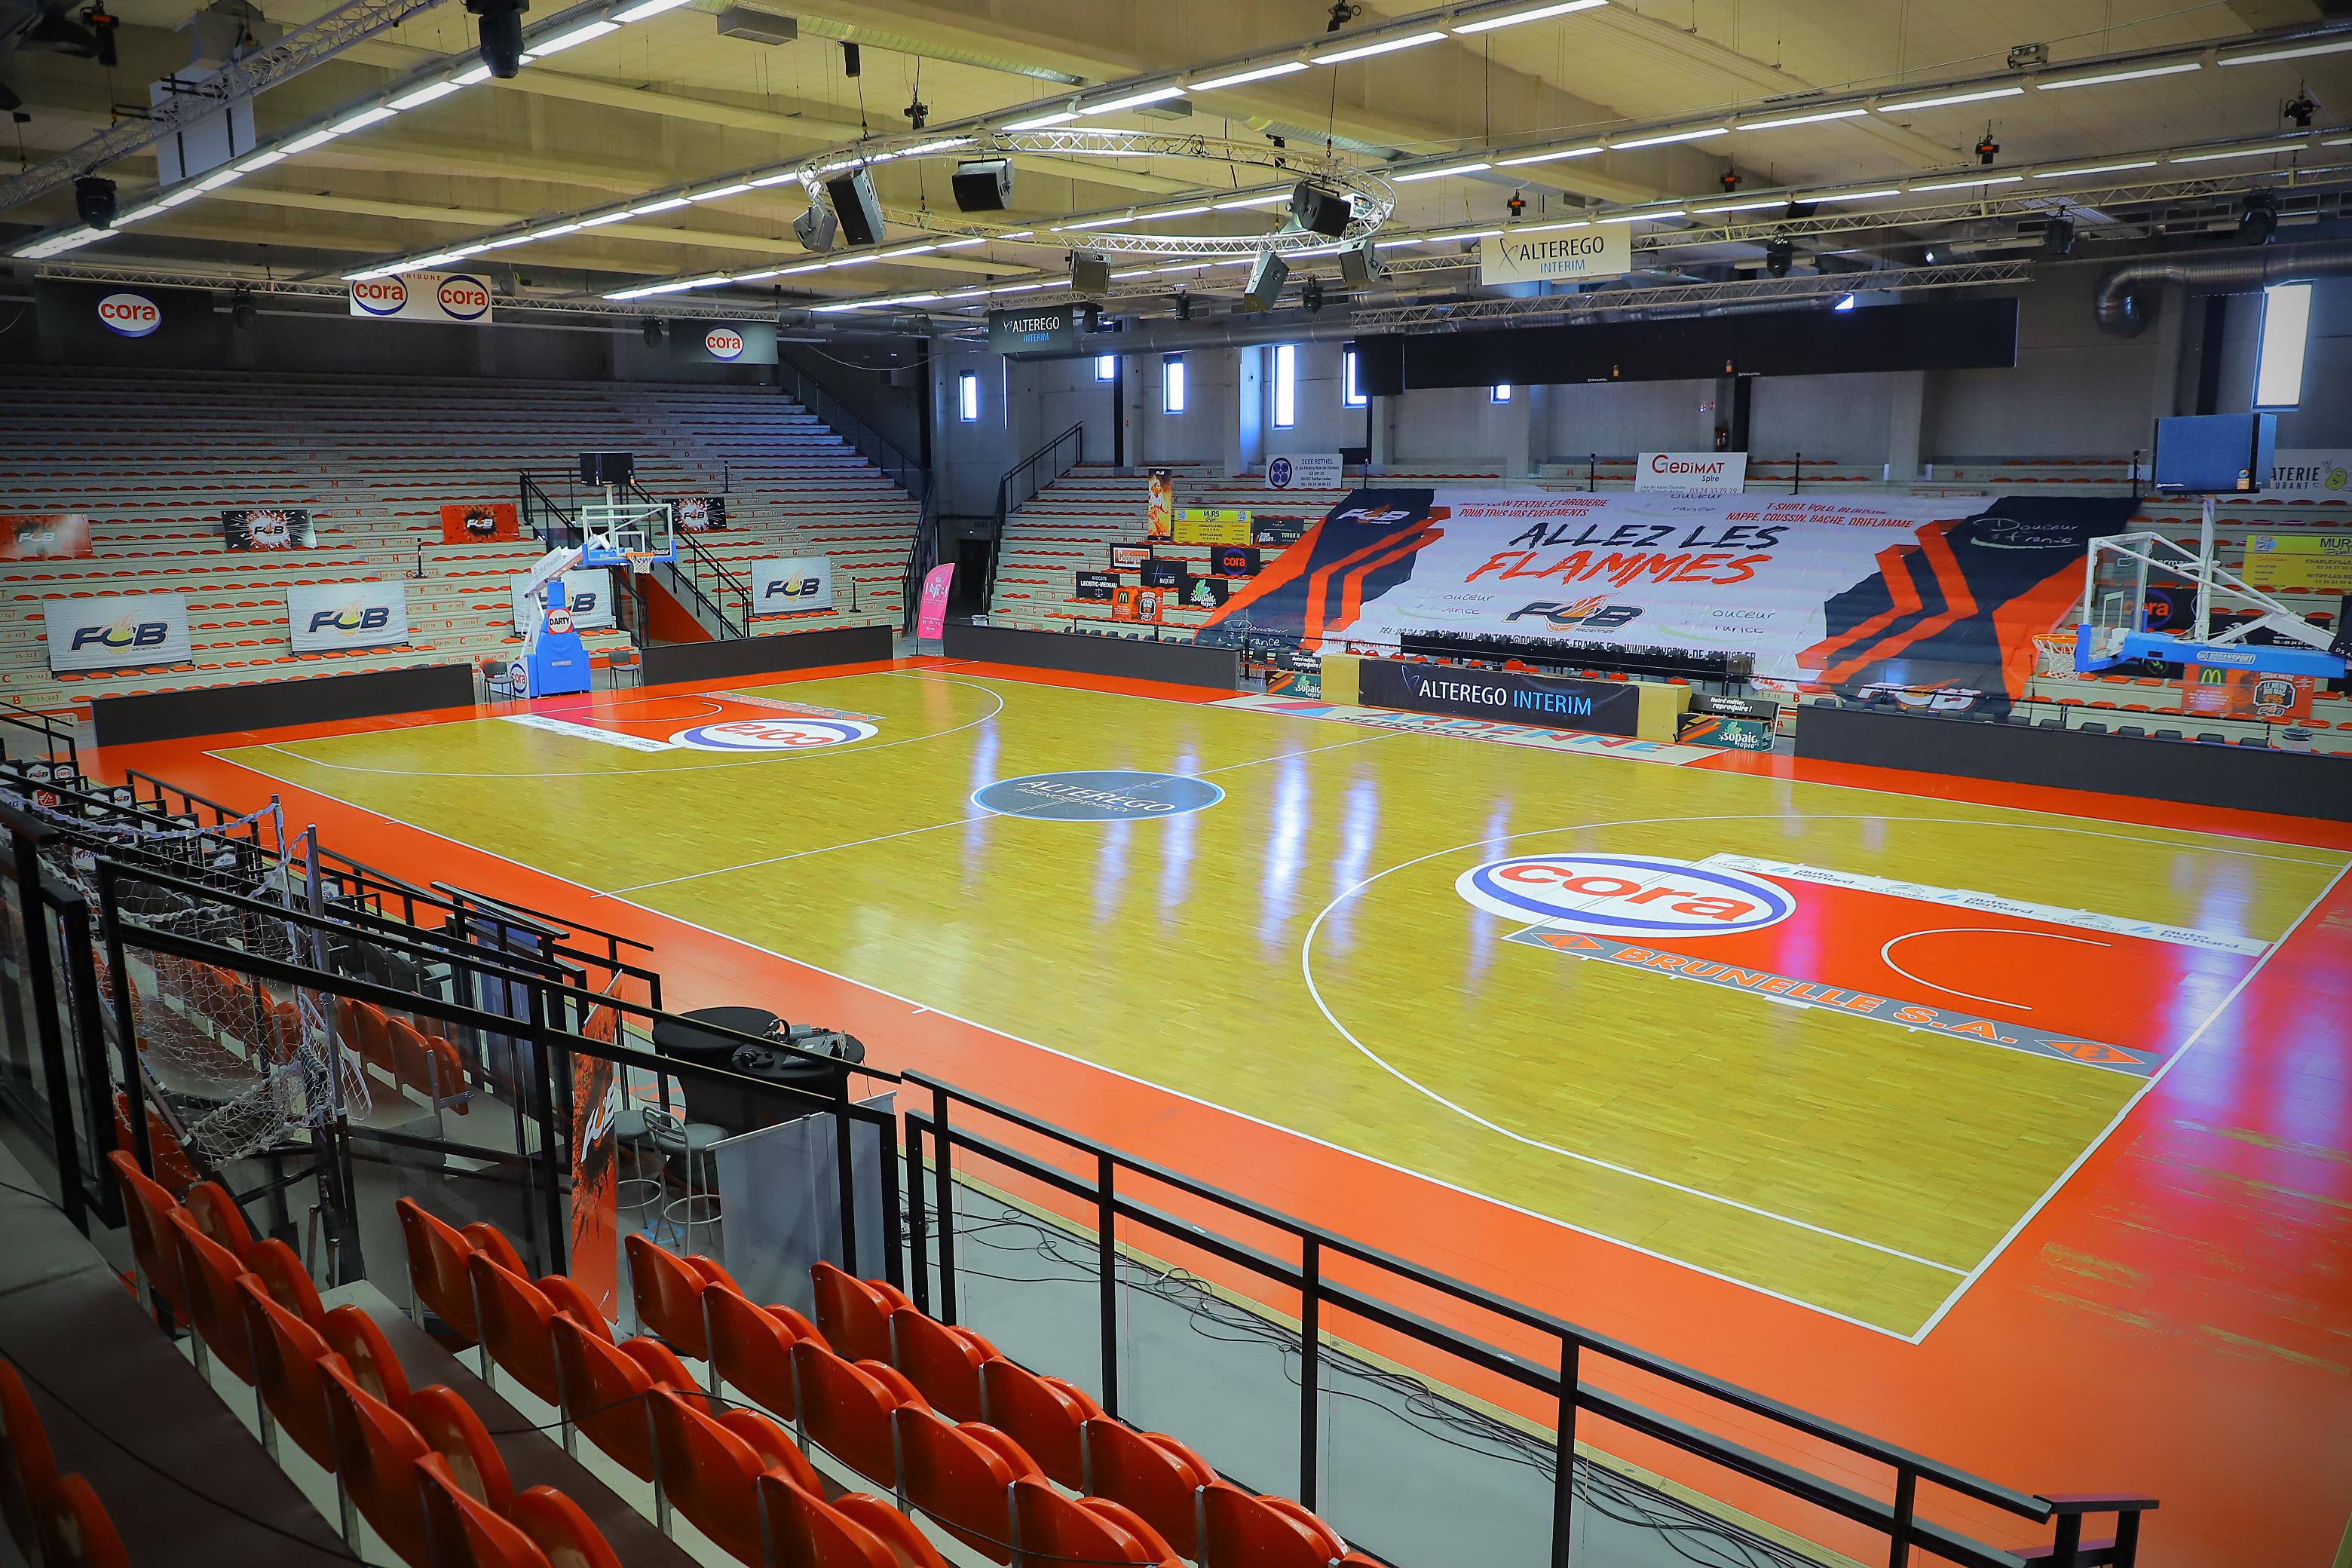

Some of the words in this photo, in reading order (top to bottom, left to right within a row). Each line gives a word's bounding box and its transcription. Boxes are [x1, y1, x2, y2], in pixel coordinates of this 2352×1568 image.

[1520, 236, 1604, 261] ALTEREGO
[1540, 259, 1585, 274] INTERIM
[402, 273, 441, 281] TRIBUNE
[355, 283, 403, 300] cora
[440, 289, 485, 306] cora
[100, 302, 157, 322] cora
[1012, 317, 1060, 332] ALTEREGO
[706, 333, 741, 351] cora
[1024, 332, 1049, 342] INTERIM
[1513, 500, 1548, 508] TEXTILE
[1548, 499, 1563, 507] ET
[1562, 498, 1610, 507] BRODERIE
[1459, 508, 1484, 517] POUR
[1484, 509, 1509, 517] TOUS
[1508, 509, 1526, 517] VOS
[1527, 508, 1590, 518] EVENEMENTS
[1726, 513, 1759, 522] NAPPE,
[1762, 513, 1806, 523] COUSSIN,
[1809, 515, 1845, 525] BACHE,
[466, 518, 493, 529] FCB
[1973, 518, 2078, 531] Douceur
[1508, 522, 1669, 549] ALLEZ
[1678, 525, 1790, 550] LES
[1223, 556, 1245, 568] cora
[1464, 550, 1773, 587] FLAMMES
[764, 576, 820, 599] FCB
[1080, 580, 1117, 589] LEOSTIC-MEDEAU
[432, 603, 438, 611] E
[308, 605, 390, 634] FCB
[549, 616, 571, 626] DARTY
[1502, 600, 1646, 629] FCB
[446, 620, 452, 629] D
[1224, 620, 1288, 634] Douceur
[70, 620, 169, 651] FCB
[459, 636, 466, 645] C
[474, 654, 481, 663] B
[2, 674, 11, 683] C
[12, 694, 21, 704] B
[1418, 679, 1507, 706] ALTEREGO
[1512, 689, 1591, 717] INTERIM
[1793, 694, 1800, 703] B
[715, 723, 835, 746] cora
[1366, 712, 1676, 754] ARDENNE
[1723, 732, 1758, 745] sopaic
[1017, 780, 1177, 812] ALTEREGO
[1793, 871, 1855, 884] bernard
[1798, 869, 1834, 877] auto
[1498, 865, 1756, 923] cora
[1963, 900, 2035, 914] bernard
[1969, 897, 2009, 906] auto
[2164, 929, 2210, 939] auto
[2159, 933, 2239, 949] bernard
[1609, 945, 1889, 1013] BRUNELLE
[1893, 1004, 2019, 1045] S.A.
